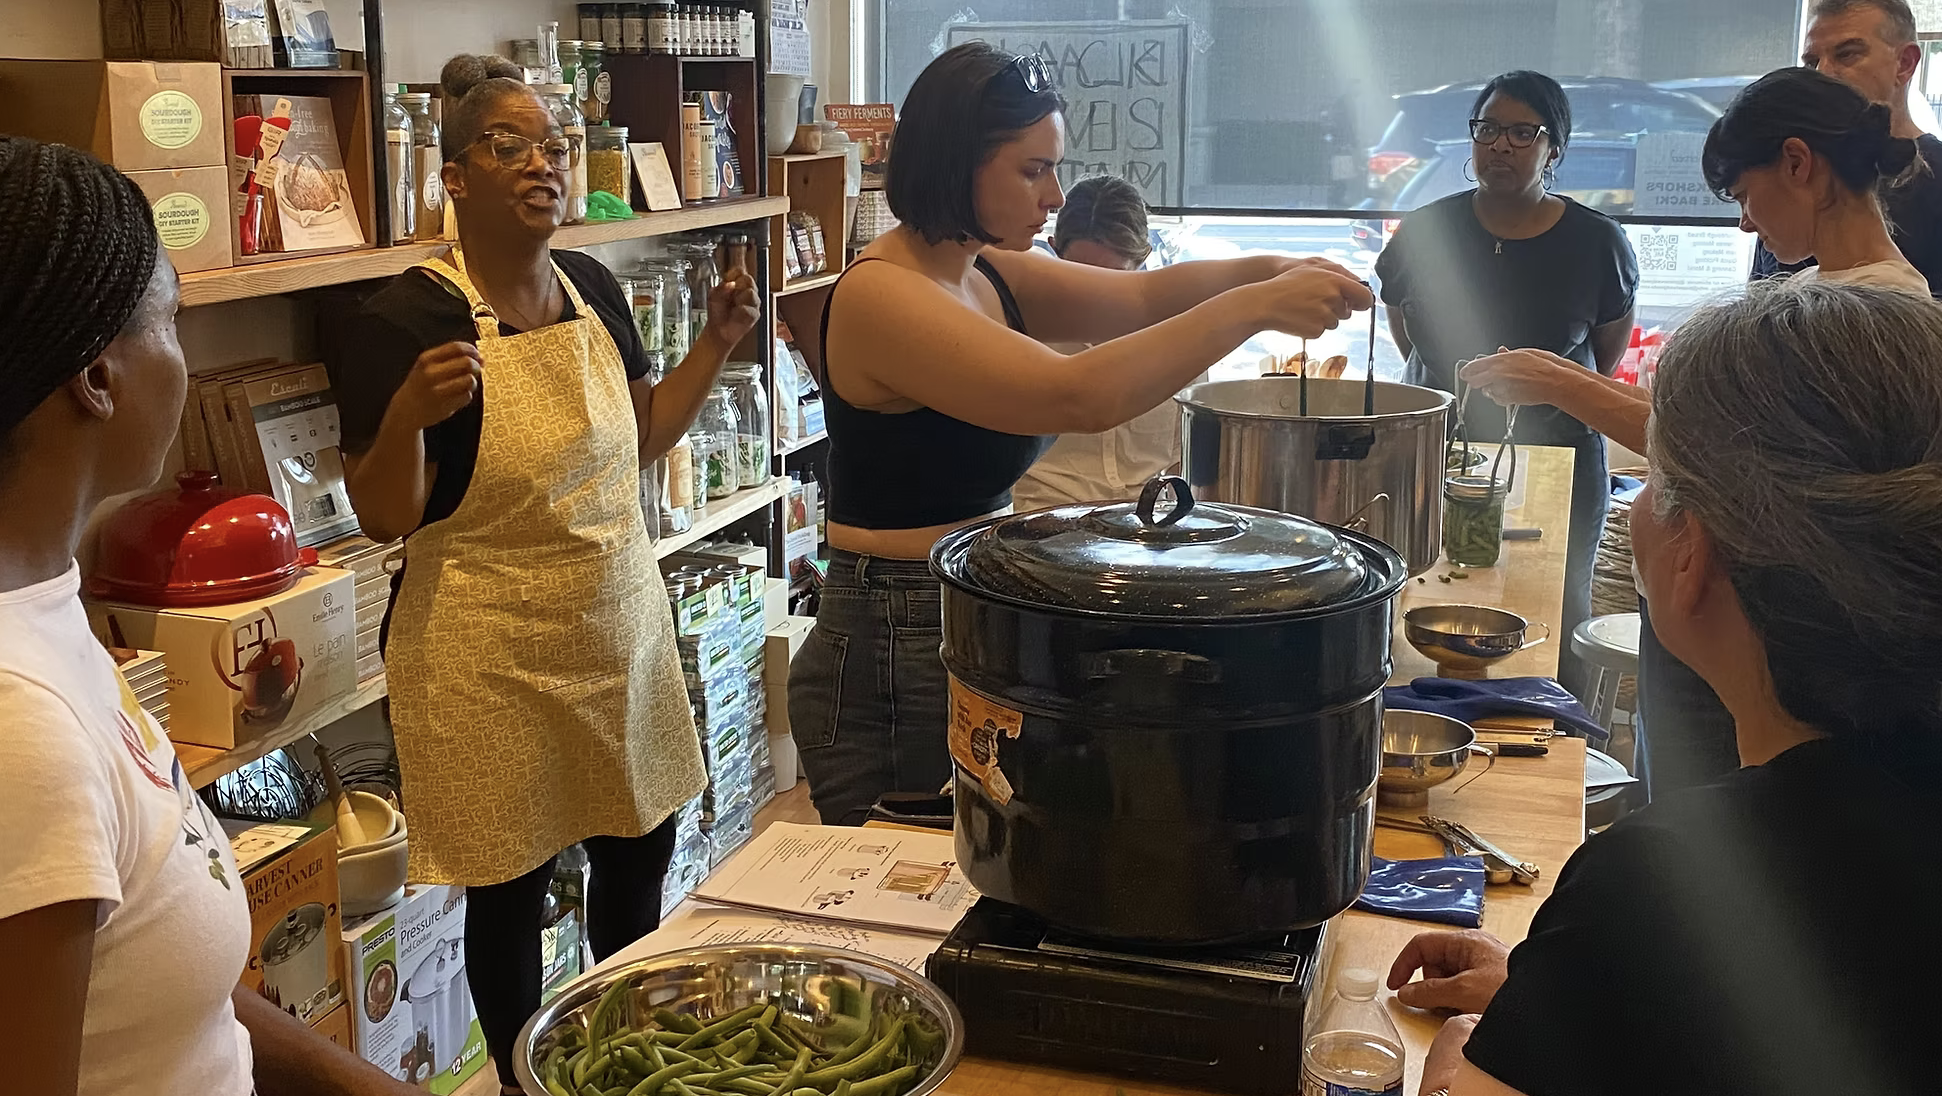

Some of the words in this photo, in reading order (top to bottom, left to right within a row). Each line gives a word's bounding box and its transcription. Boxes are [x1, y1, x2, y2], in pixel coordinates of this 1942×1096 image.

[151, 109, 192, 117] SOURDOUGH
[832, 108, 851, 120] FIERY
[853, 107, 892, 122] FERMENTS
[158, 209, 200, 219] SOURDOUGH
[168, 219, 191, 227] STARTER
[270, 377, 308, 396] Escali
[279, 400, 304, 412] BAMBOO
[304, 396, 321, 406] SCALE
[328, 604, 344, 616] Henry
[313, 643, 324, 658] Le
[327, 633, 347, 657] pain
[247, 858, 293, 896] ARVEST
[248, 888, 272, 914] USE
[274, 857, 323, 898] CANNER
[400, 910, 441, 945] Pressure
[443, 892, 467, 915] Cann
[400, 908, 425, 930] 23-quart
[362, 927, 395, 956] PRESTO
[401, 946, 412, 958] and
[412, 931, 433, 951] Cooker
[451, 1058, 461, 1075] 12
[461, 1041, 482, 1063] YEAR
